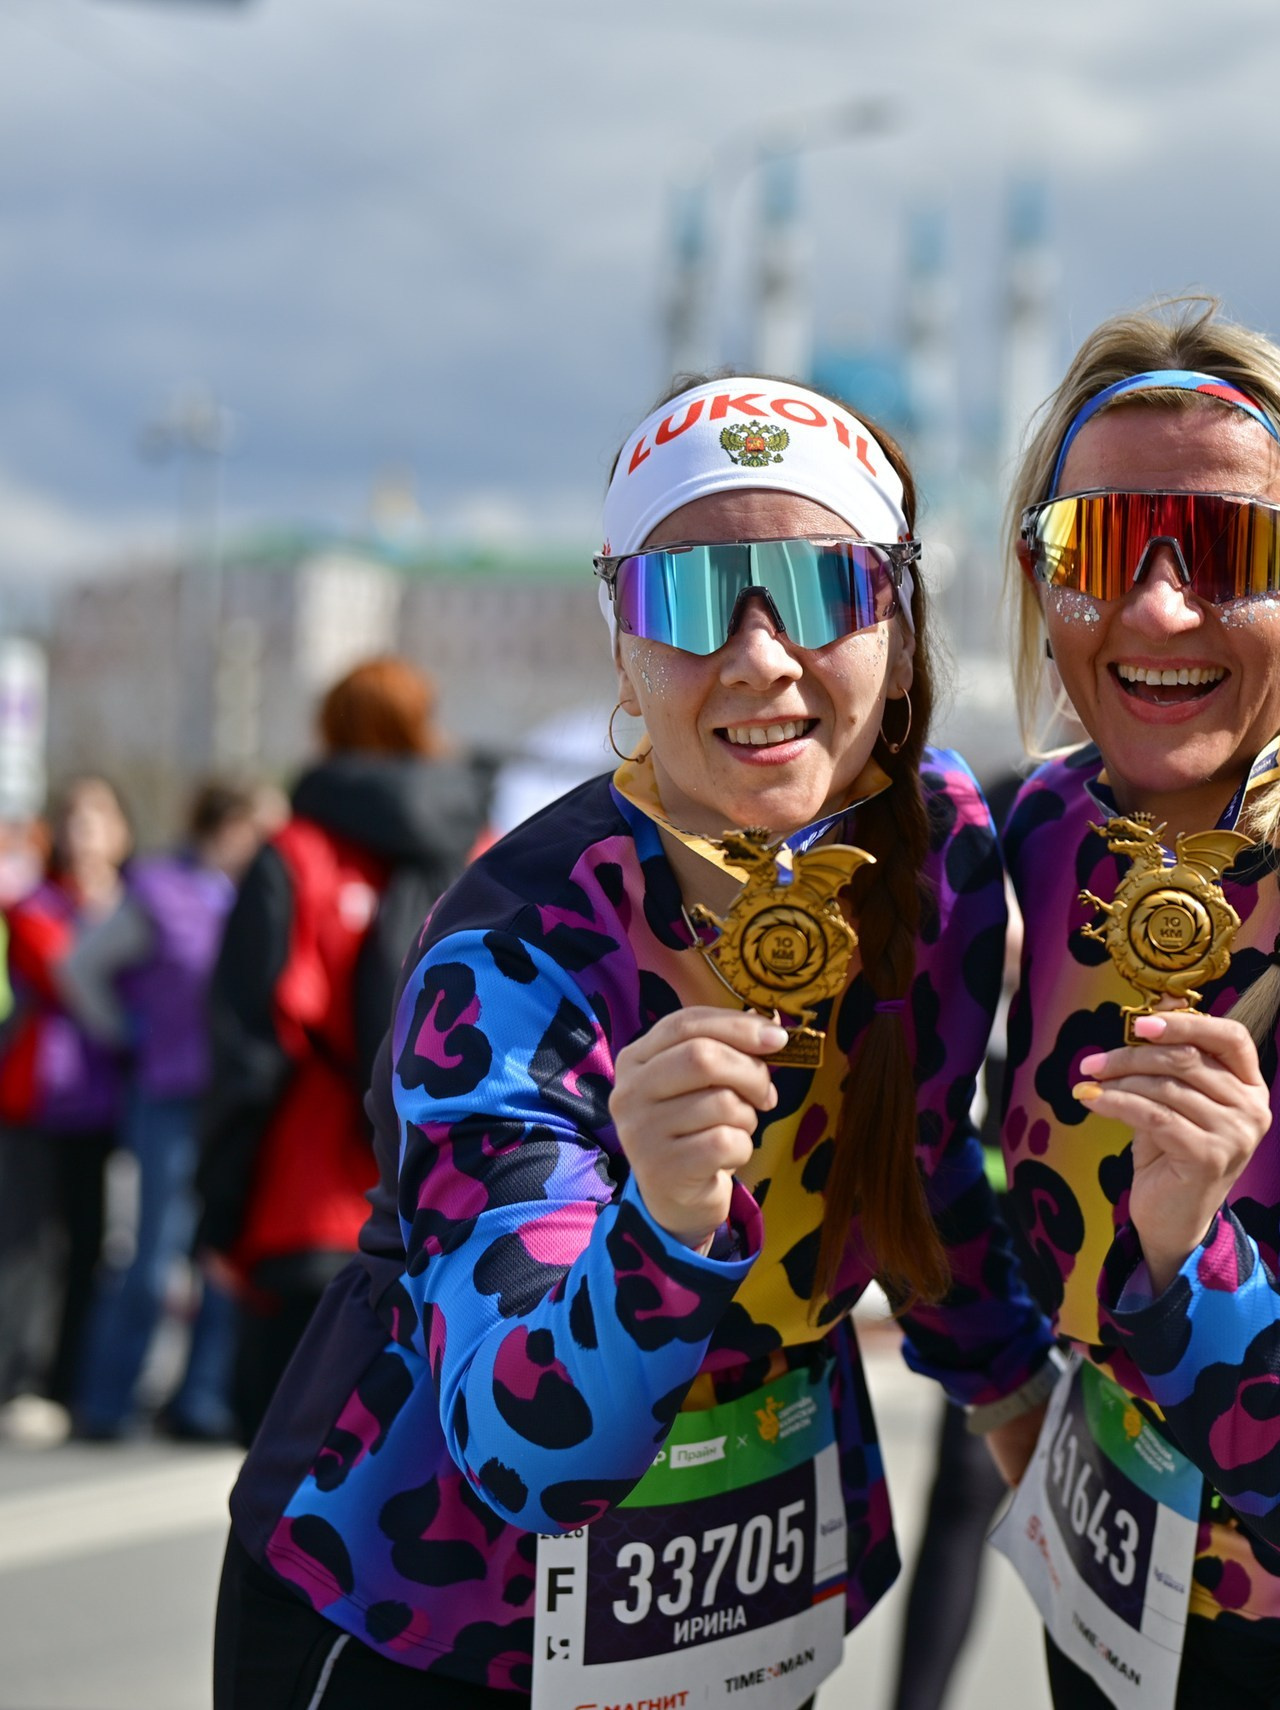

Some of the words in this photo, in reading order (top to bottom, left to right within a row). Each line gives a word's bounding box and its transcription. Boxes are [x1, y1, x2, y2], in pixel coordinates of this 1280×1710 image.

[628, 393, 878, 477] LUKOIL
[677, 1446, 717, 1462] Прайм
[612, 1500, 806, 1625] 33705
[547, 1567, 575, 1612] F
[673, 1605, 748, 1645] ИРИНА
